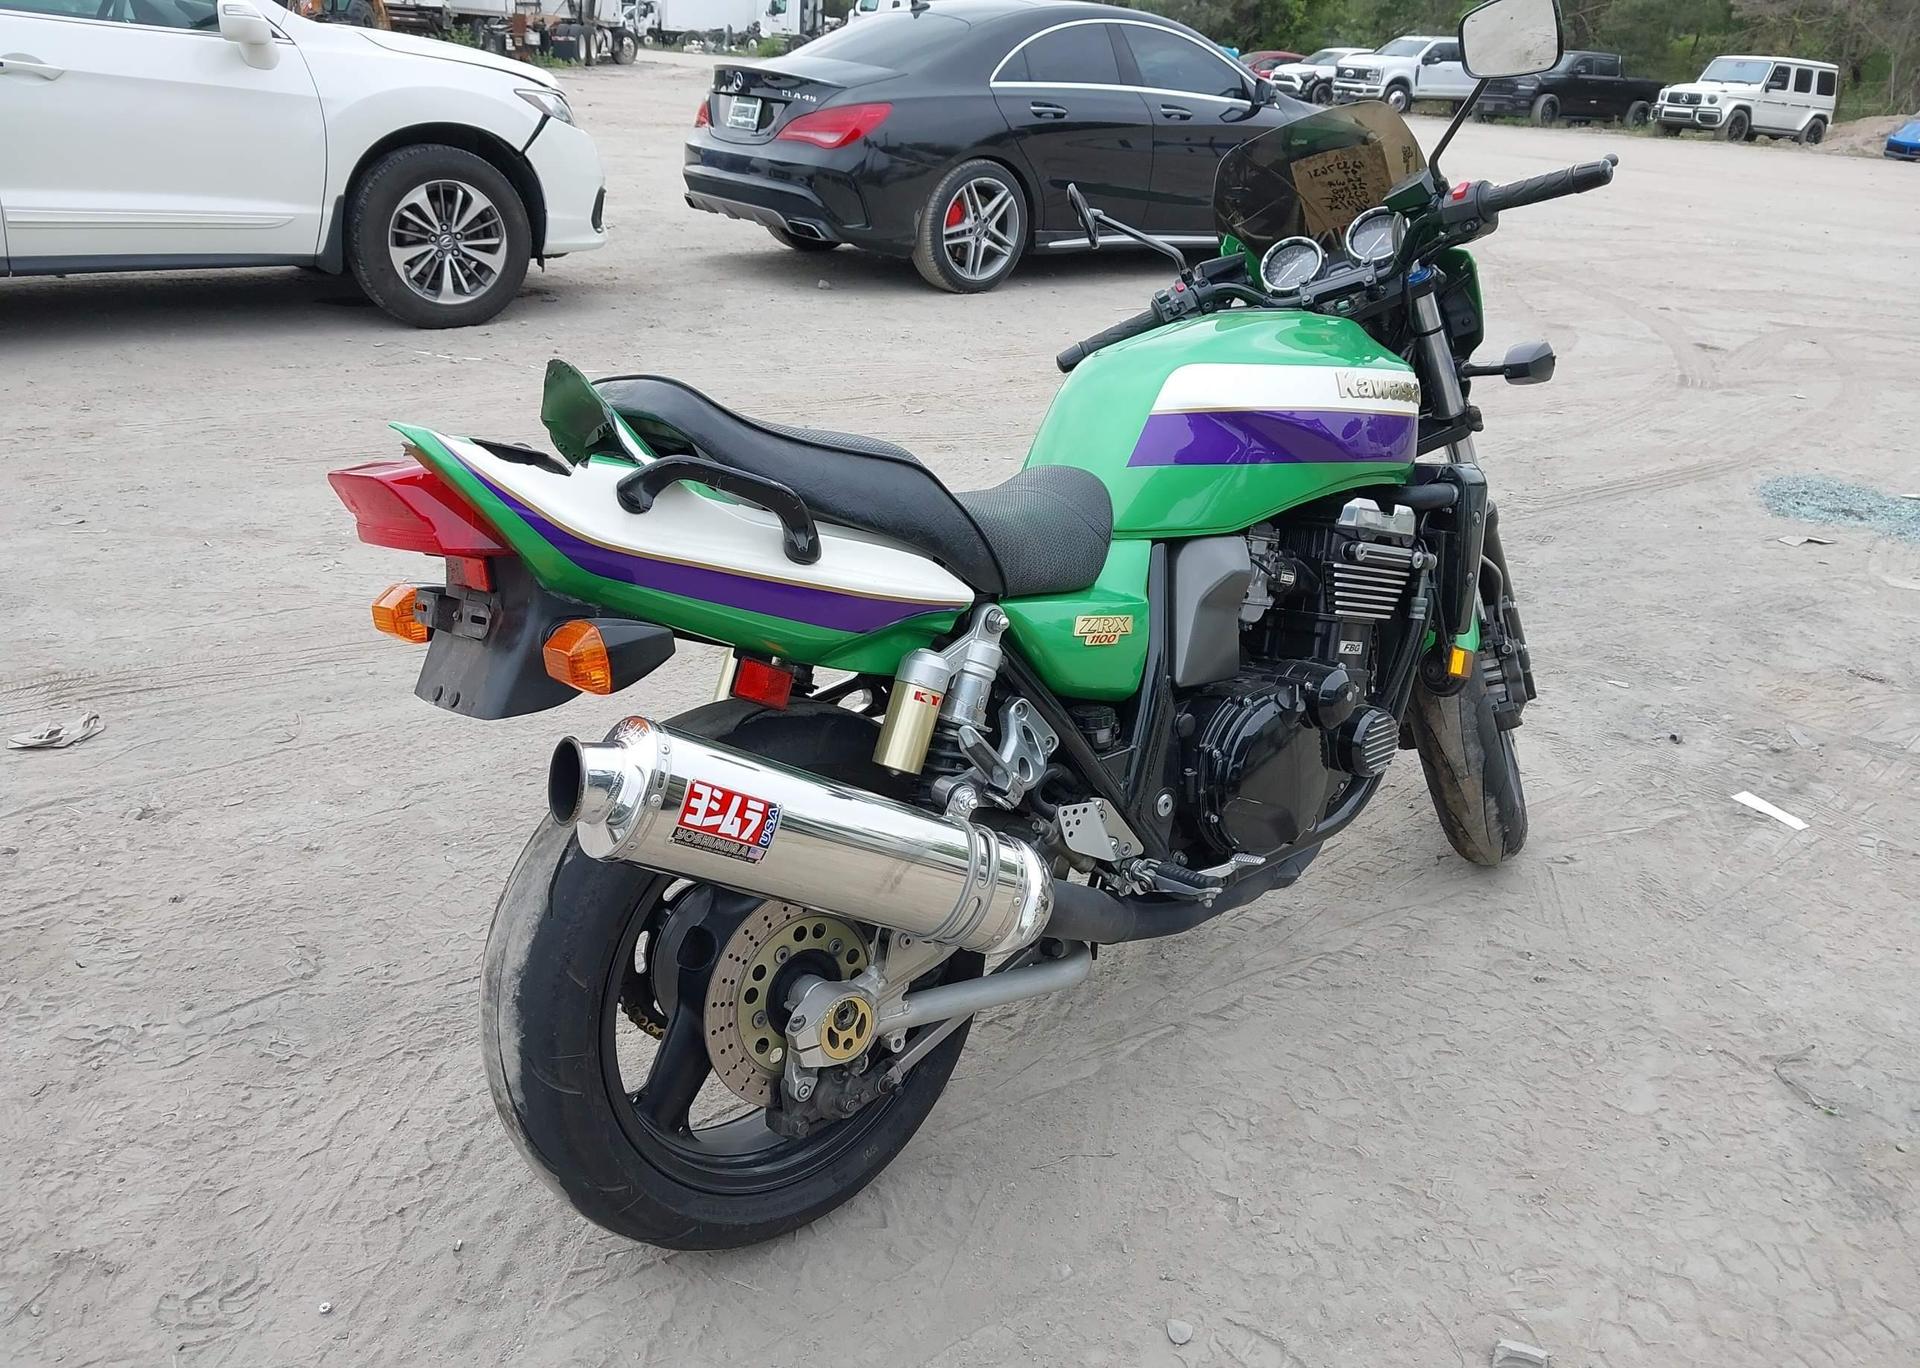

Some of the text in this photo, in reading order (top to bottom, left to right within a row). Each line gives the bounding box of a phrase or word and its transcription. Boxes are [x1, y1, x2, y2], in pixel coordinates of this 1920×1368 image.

[1079, 617, 1129, 634] ZRX
[1090, 634, 1117, 644] 1100
[683, 782, 765, 841] ヨシムラ
[759, 807, 779, 846] USA
[675, 828, 749, 857] YOSHIMURA
